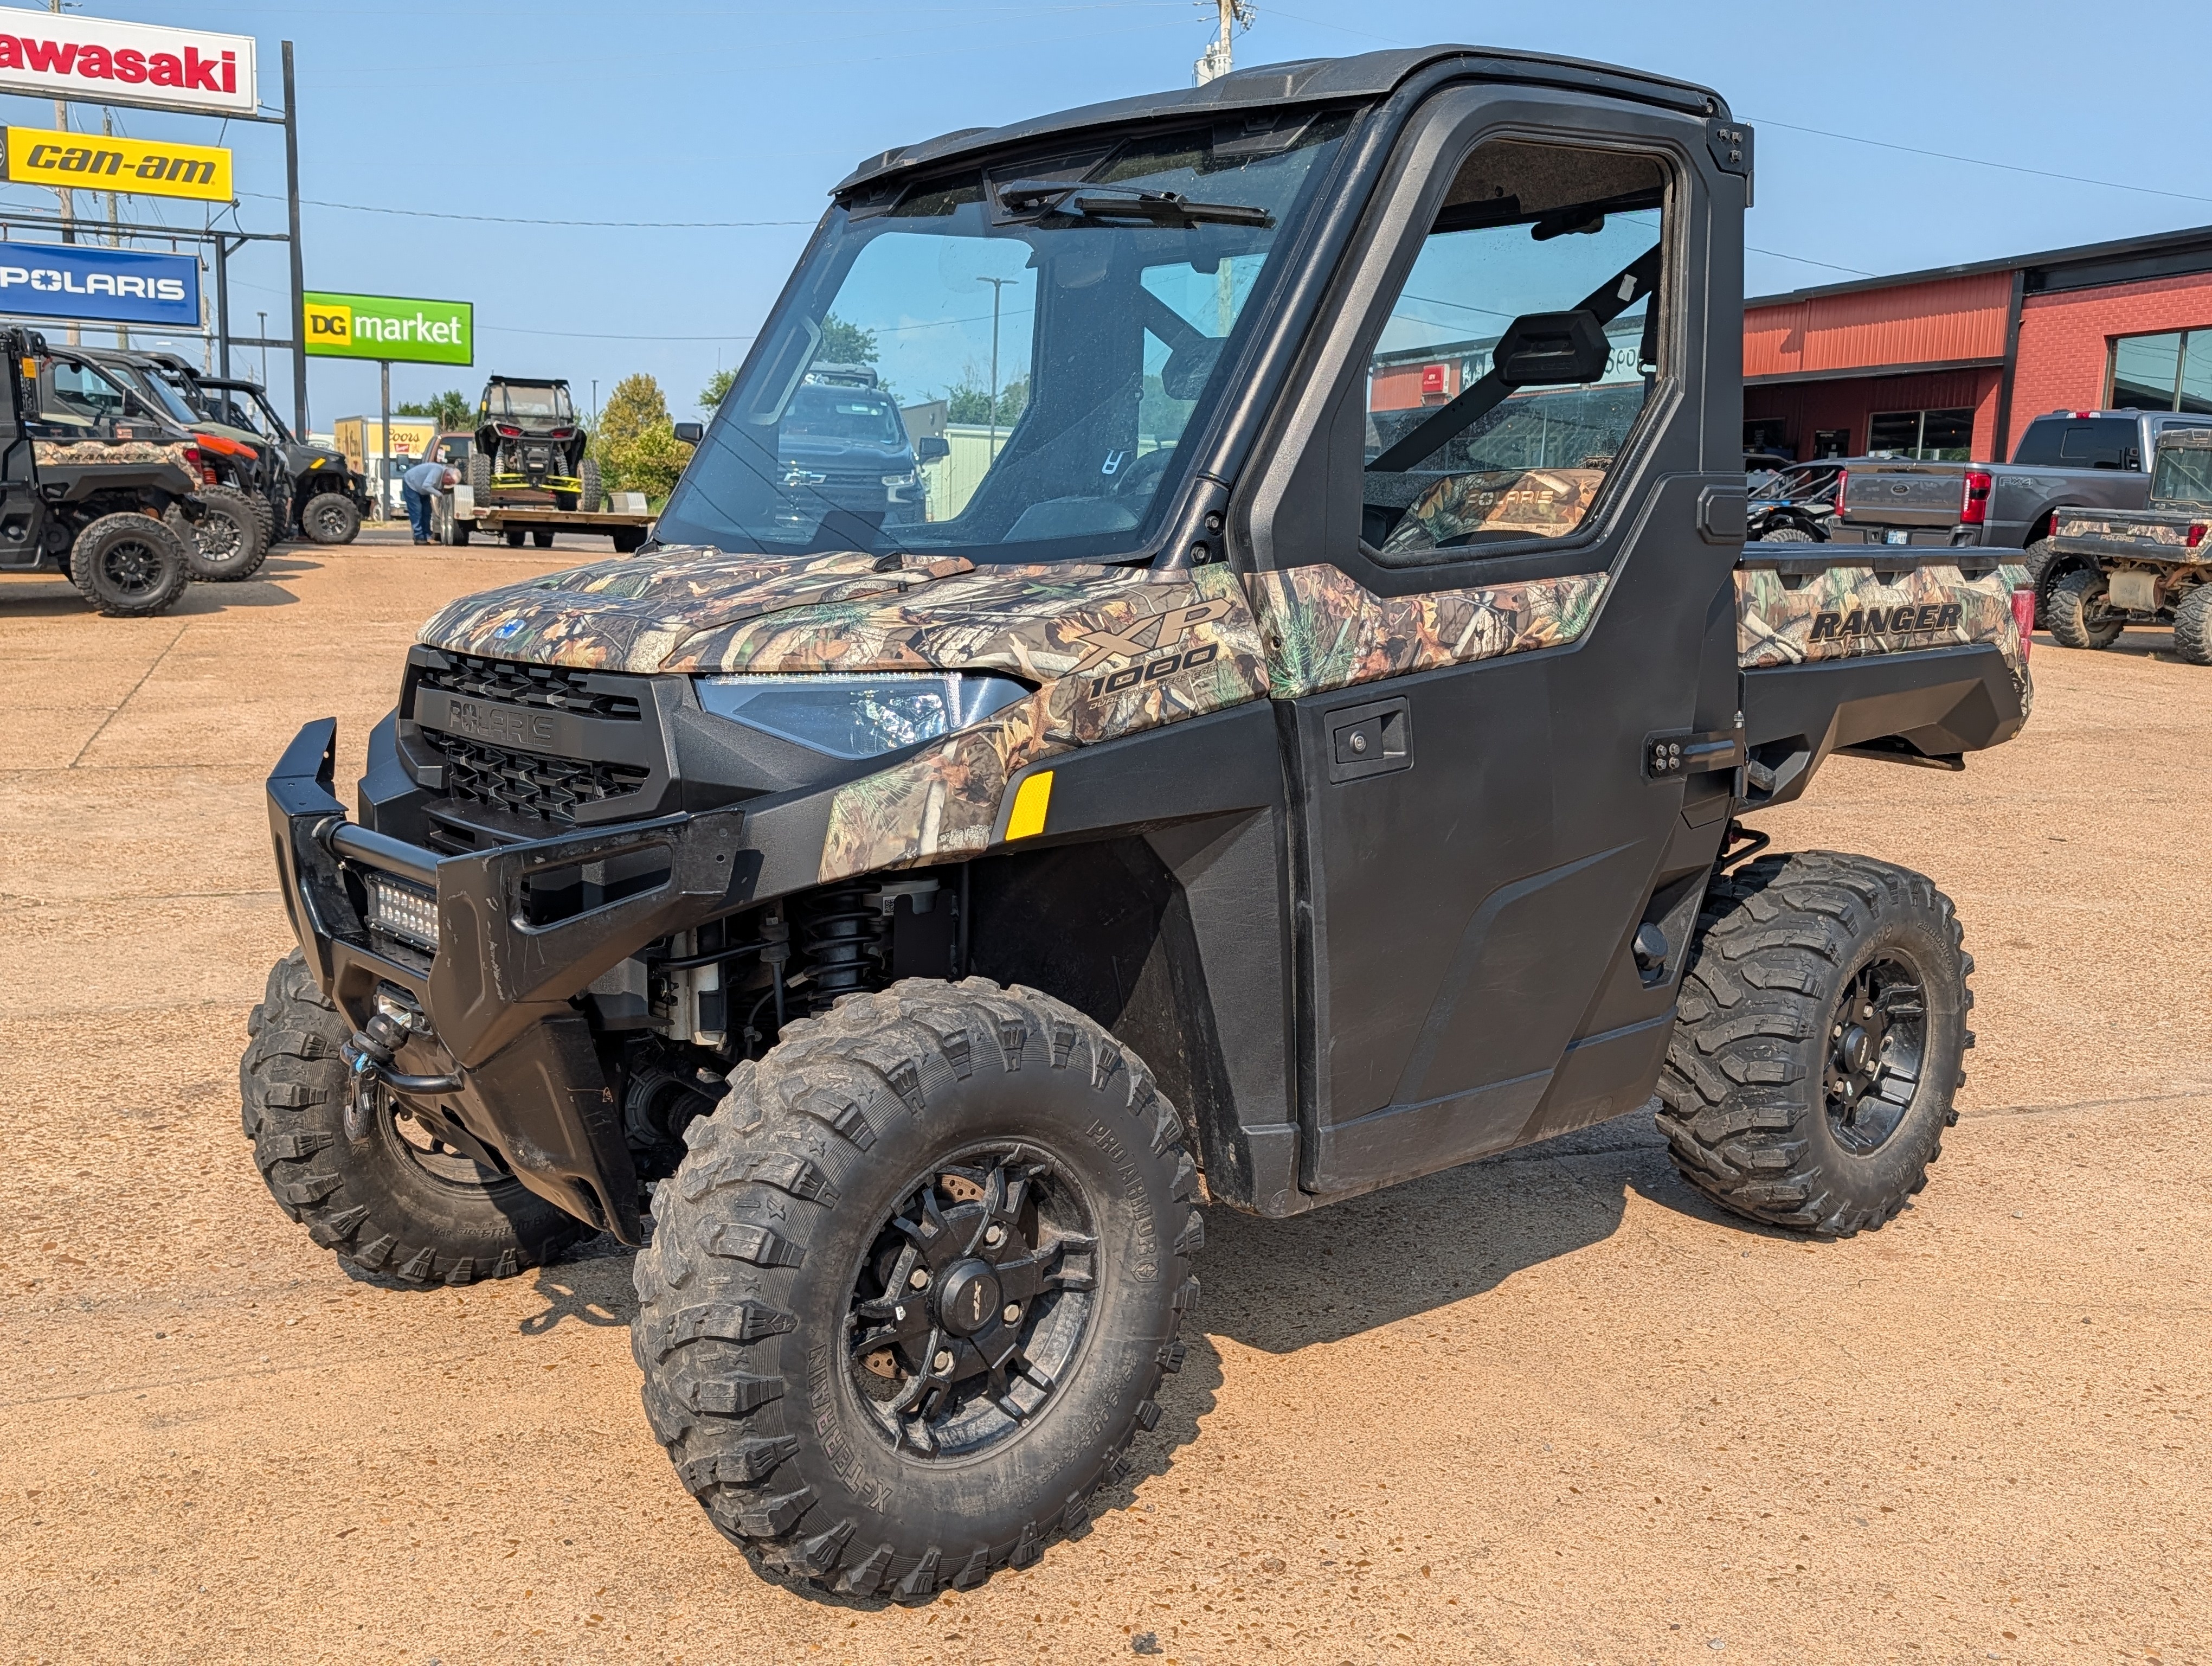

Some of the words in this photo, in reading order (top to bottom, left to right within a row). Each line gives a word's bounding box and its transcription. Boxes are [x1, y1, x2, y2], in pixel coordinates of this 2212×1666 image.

[27, 144, 216, 185] can-am
[0, 266, 185, 300] POLARIS
[310, 314, 346, 336] DG
[355, 312, 462, 344] market
[1605, 347, 1639, 375] Spo
[1464, 491, 1554, 507] POLARIS
[1999, 477, 2033, 487] FX4
[2100, 534, 2136, 542] POLARIS
[1064, 597, 1236, 676] XP
[1808, 602, 1963, 643] RANGER
[1088, 642, 1220, 702] 1000
[1089, 695, 1122, 710] DUAL
[1124, 675, 1192, 699] OVERHEAD
[1192, 665, 1218, 678] CAM
[449, 700, 554, 748] POLARIS
[1086, 1119, 1128, 1163] PRO
[1117, 1163, 1157, 1256] ARMOR
[808, 1343, 893, 1516] X-TERRAIN
